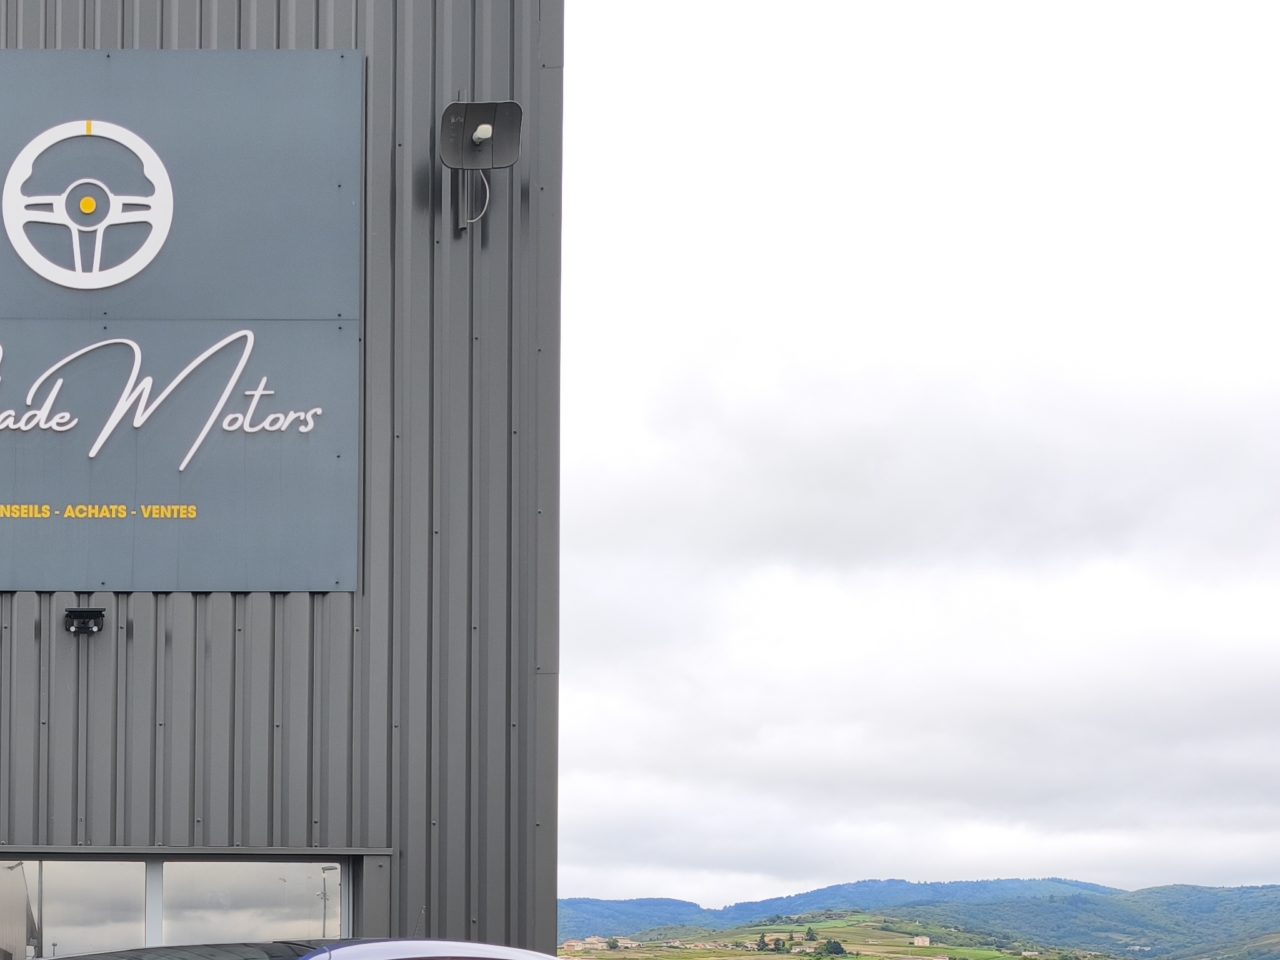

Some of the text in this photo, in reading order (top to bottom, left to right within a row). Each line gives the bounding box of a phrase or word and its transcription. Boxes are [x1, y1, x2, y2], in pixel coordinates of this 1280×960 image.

[26, 329, 322, 472] Motors
[63, 504, 127, 519] ACHATS
[140, 504, 197, 519] VENTES
